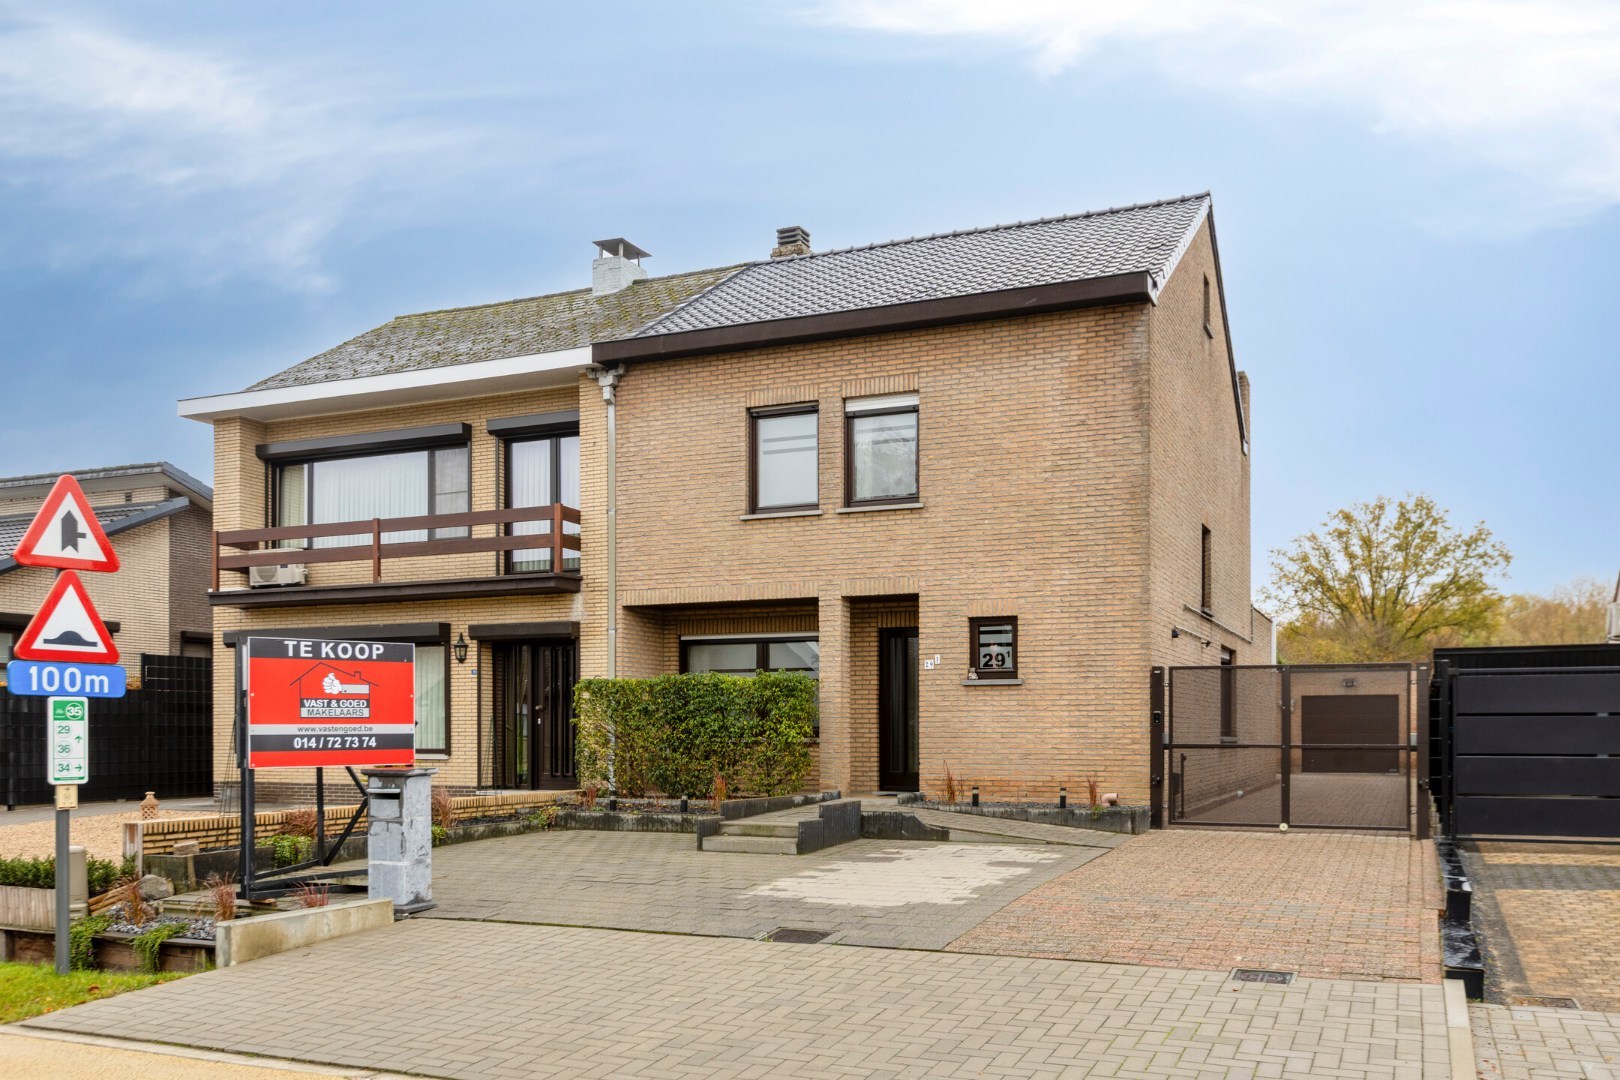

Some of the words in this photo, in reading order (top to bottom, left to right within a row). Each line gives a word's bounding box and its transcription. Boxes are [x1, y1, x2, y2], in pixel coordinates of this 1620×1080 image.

[284, 641, 313, 657] TE
[321, 643, 384, 659] KOOP
[29, 666, 109, 693] 100m
[303, 699, 329, 708] VAST
[331, 699, 338, 708] &
[339, 699, 367, 708] GOED
[67, 706, 82, 716] 35
[307, 708, 364, 717] MAKELAARS
[57, 725, 71, 734] 29
[293, 737, 317, 749] 014
[326, 737, 342, 748] 72
[344, 737, 359, 748] 73
[362, 736, 377, 748] 74
[57, 744, 71, 753] 36
[57, 763, 71, 772] 34
